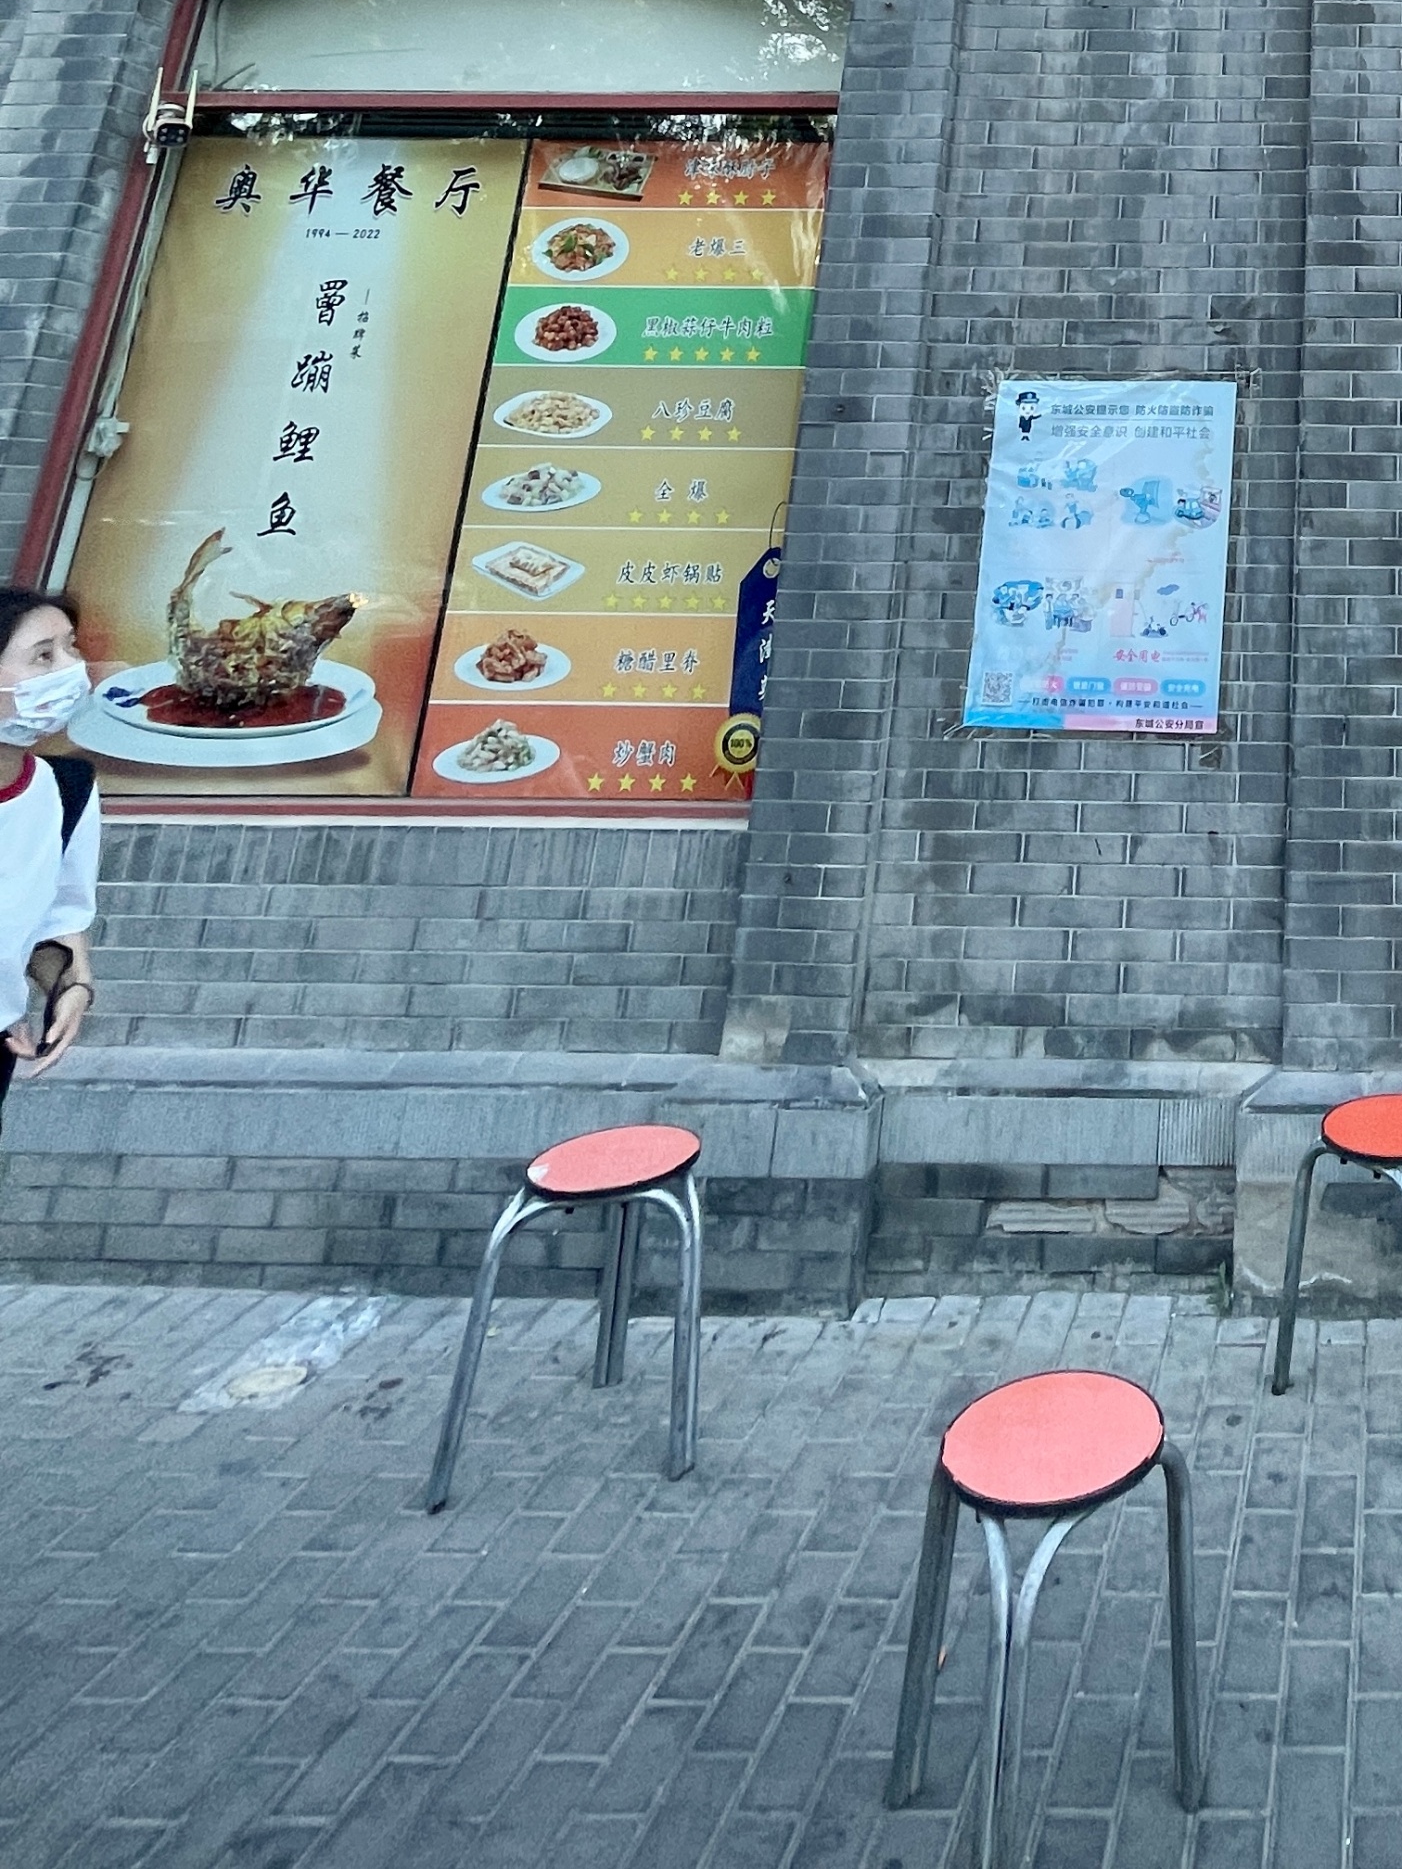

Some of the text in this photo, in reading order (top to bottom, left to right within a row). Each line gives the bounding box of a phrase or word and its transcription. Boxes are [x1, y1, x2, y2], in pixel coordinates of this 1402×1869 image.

[215, 163, 482, 218] 奥华餐厅
[688, 237, 747, 258] 老爆三
[651, 397, 735, 423] 八珍豆腐
[617, 561, 724, 585] 皮皮虾锅贴
[614, 647, 701, 674] 糖醋里脊
[611, 739, 677, 768] 炒蟹肉
